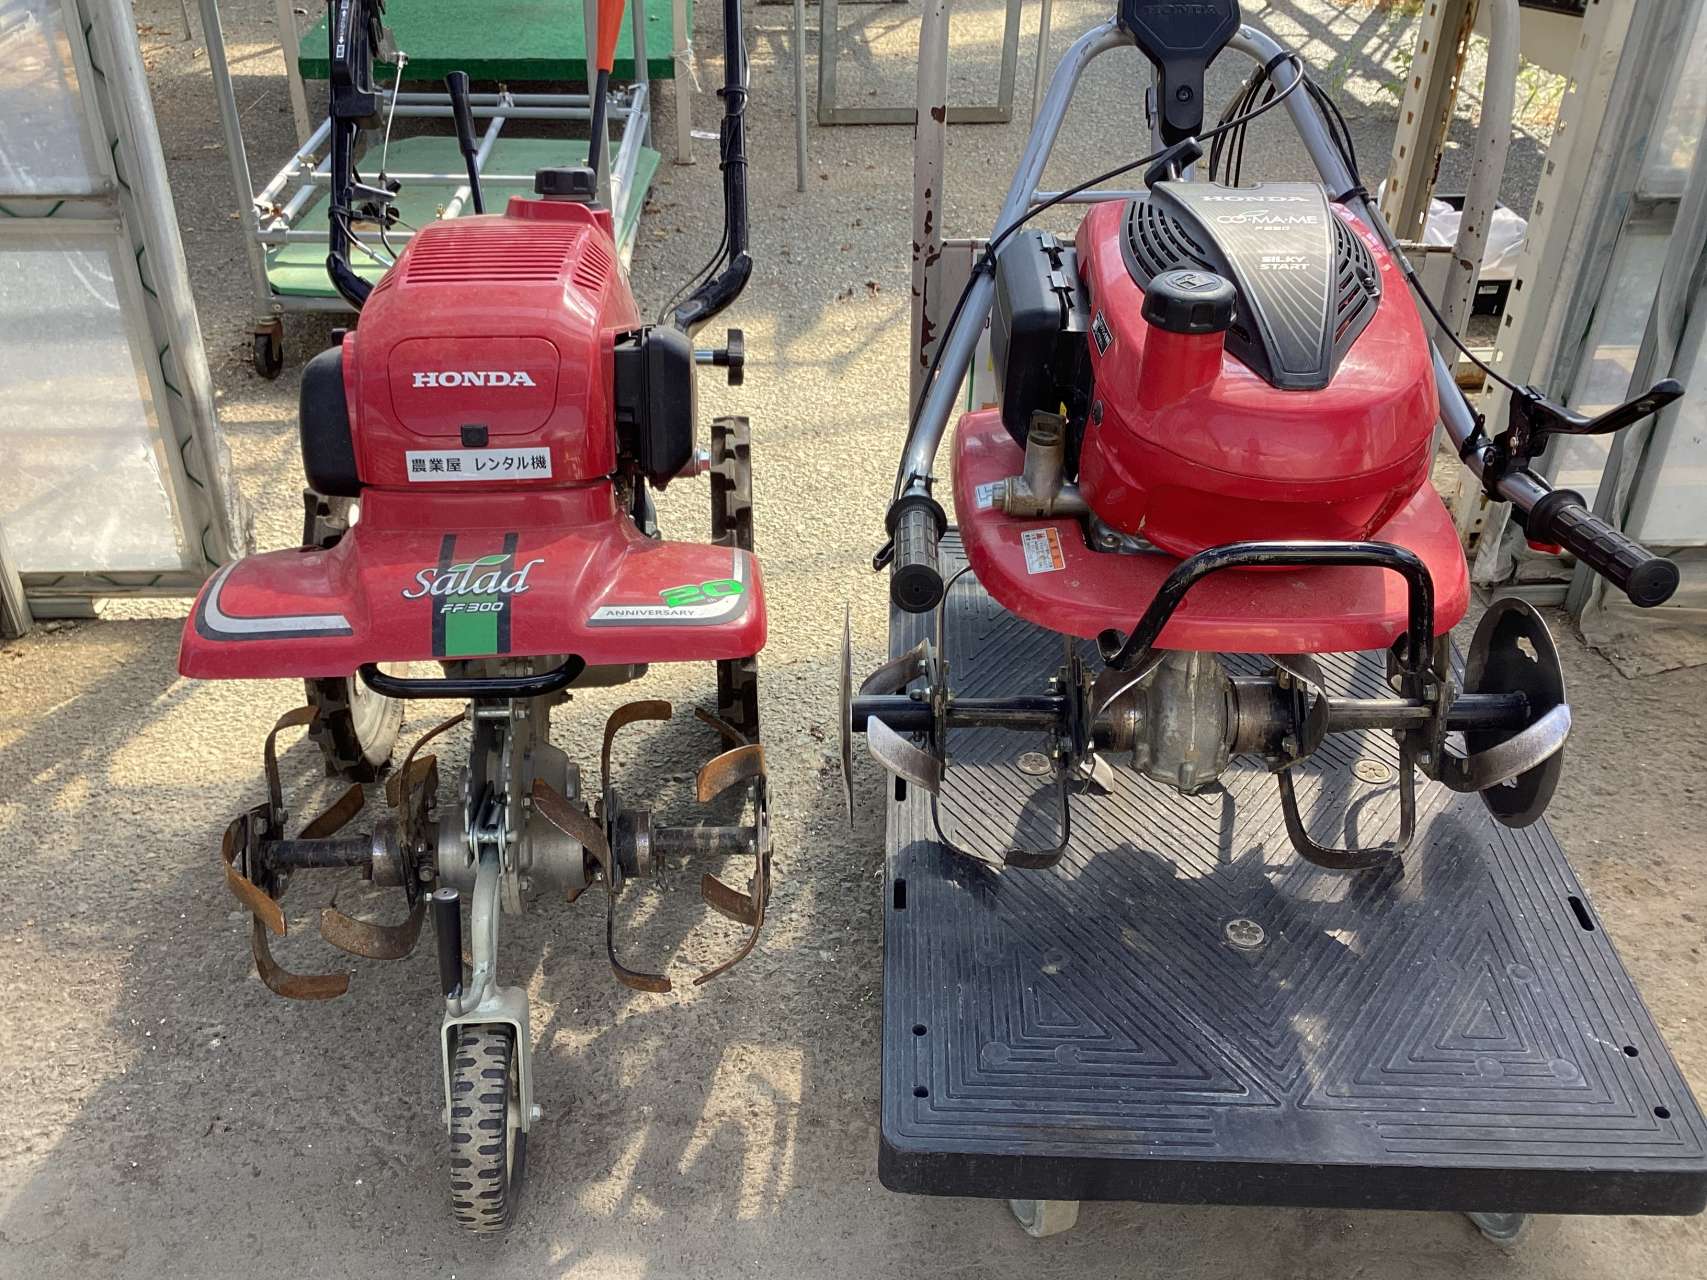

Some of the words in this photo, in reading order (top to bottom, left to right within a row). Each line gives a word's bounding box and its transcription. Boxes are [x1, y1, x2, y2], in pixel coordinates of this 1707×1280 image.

[1258, 263, 1311, 271] START
[412, 371, 537, 388] HONDA
[411, 457, 463, 473] 農業屋
[474, 453, 548, 471] レンタル機
[401, 557, 546, 599] Salad
[658, 579, 745, 609] 20
[605, 609, 697, 617] ANNIVERSARY
